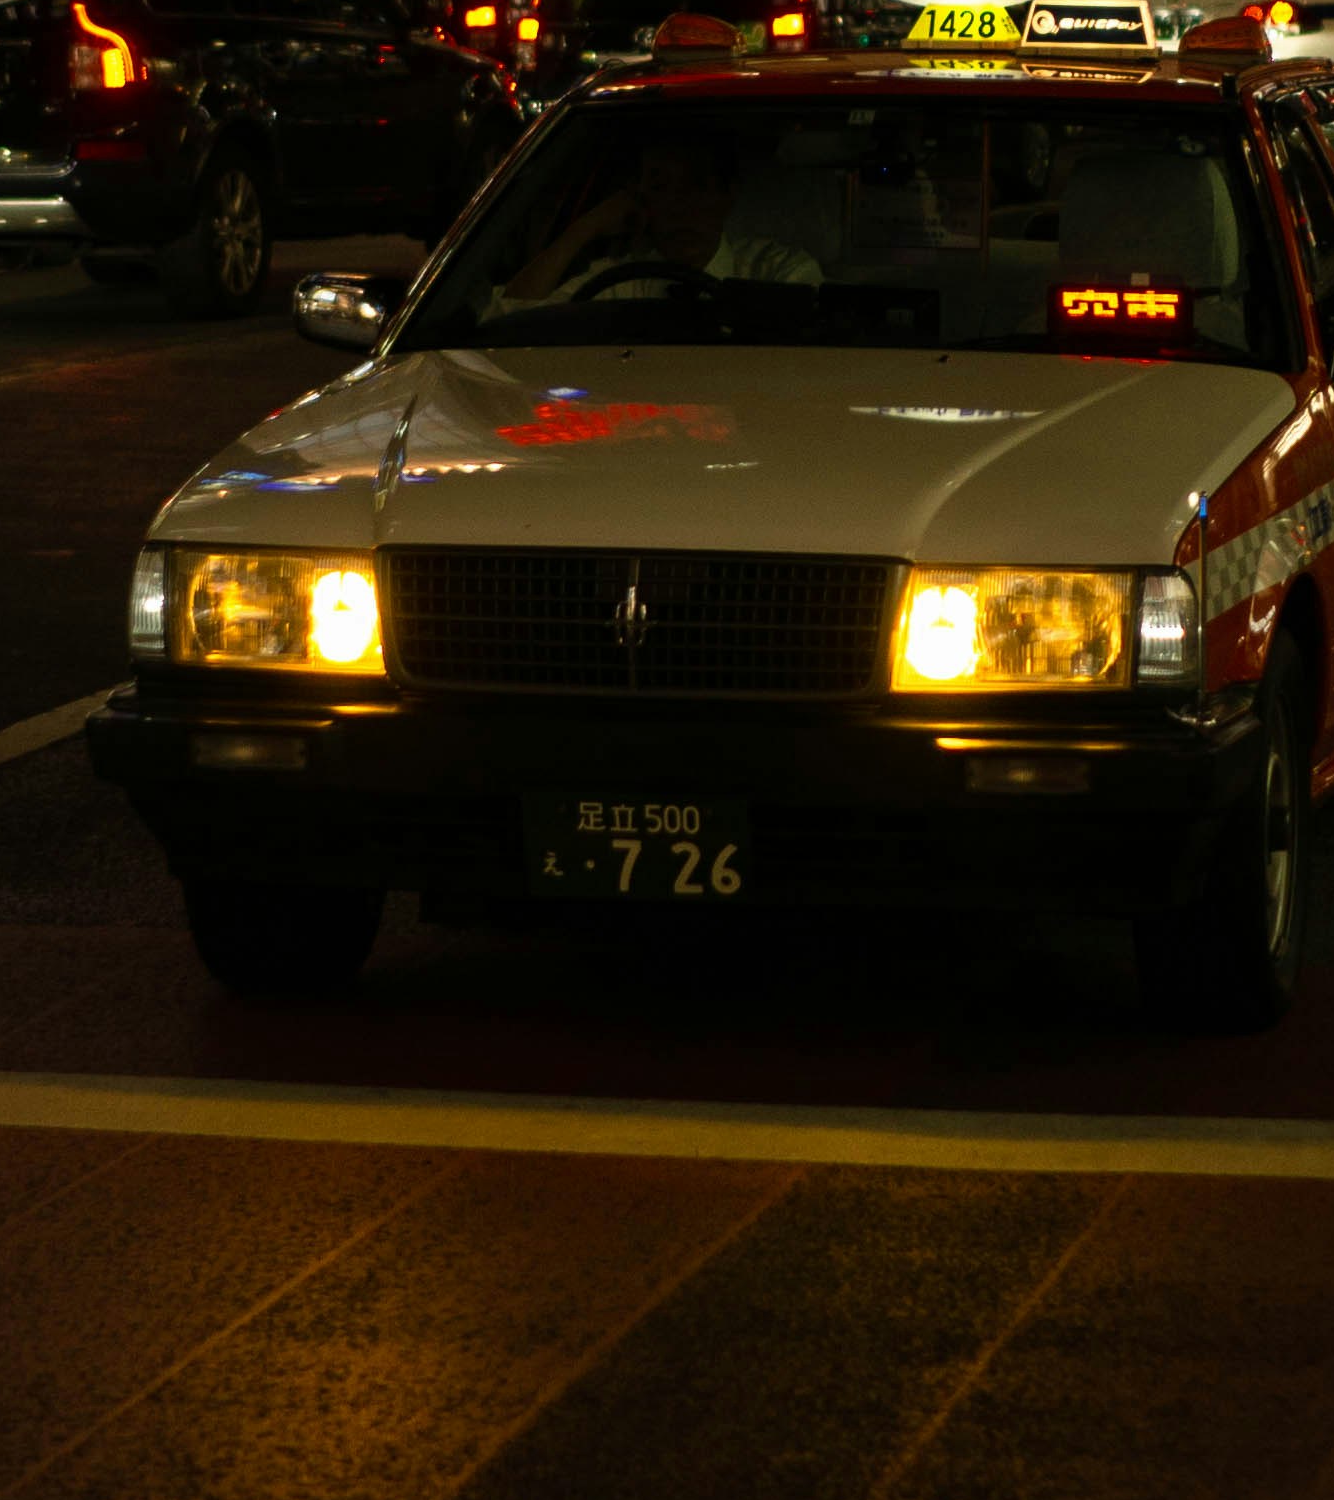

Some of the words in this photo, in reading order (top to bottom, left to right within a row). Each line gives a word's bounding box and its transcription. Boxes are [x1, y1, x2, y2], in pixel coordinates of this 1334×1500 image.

[925, 9, 996, 38] 1428
[578, 801, 638, 832] 足立
[644, 804, 701, 834] 500
[543, 851, 564, 876] え
